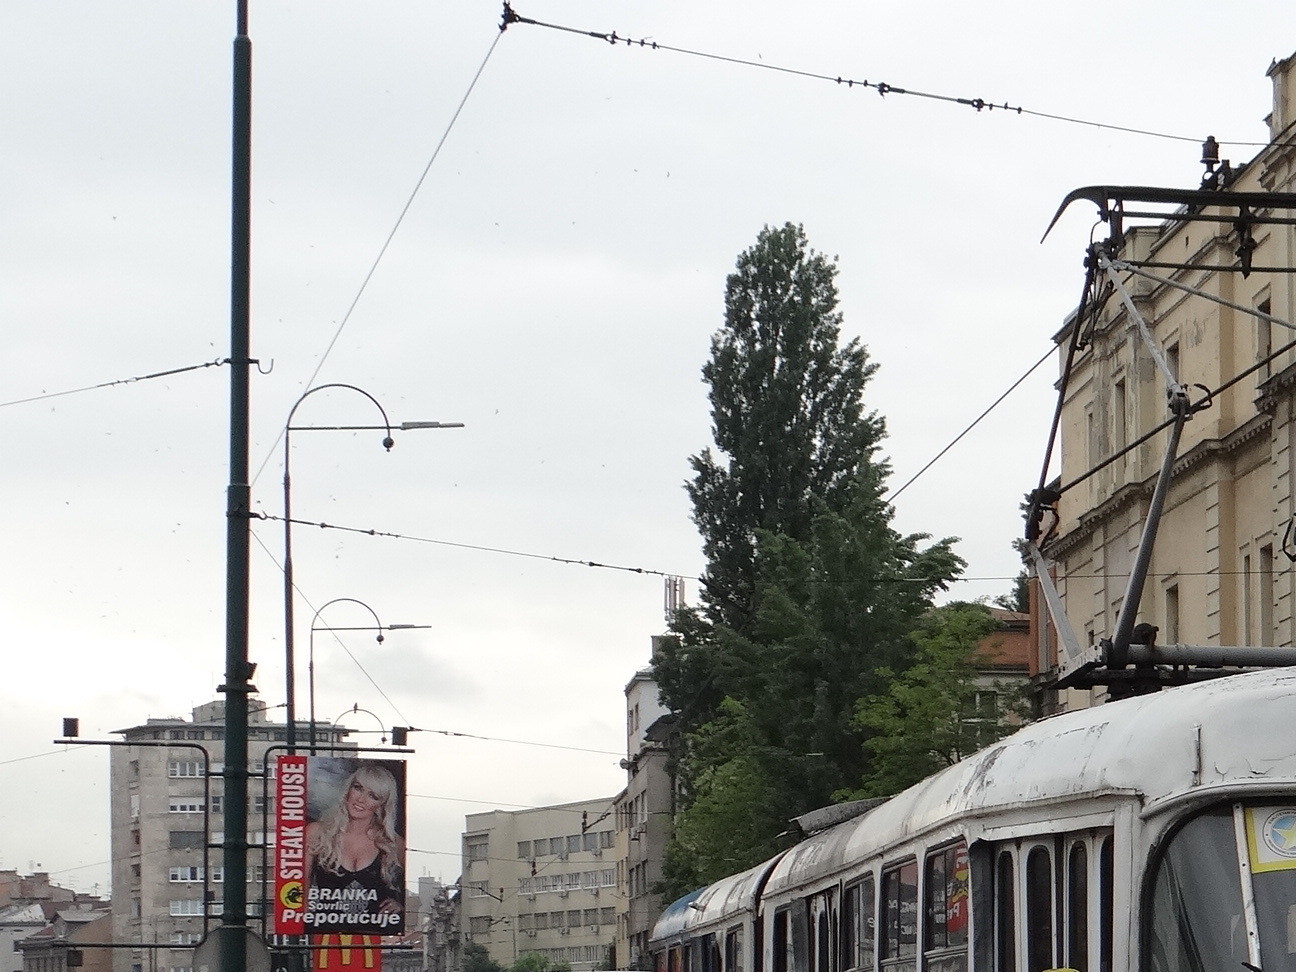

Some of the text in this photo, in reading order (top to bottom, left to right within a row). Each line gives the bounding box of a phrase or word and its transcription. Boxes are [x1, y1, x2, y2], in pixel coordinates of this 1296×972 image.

[280, 763, 305, 880] STEAK HOUSE
[307, 888, 378, 901] BRANKA
[281, 909, 401, 927] Preporučuje
